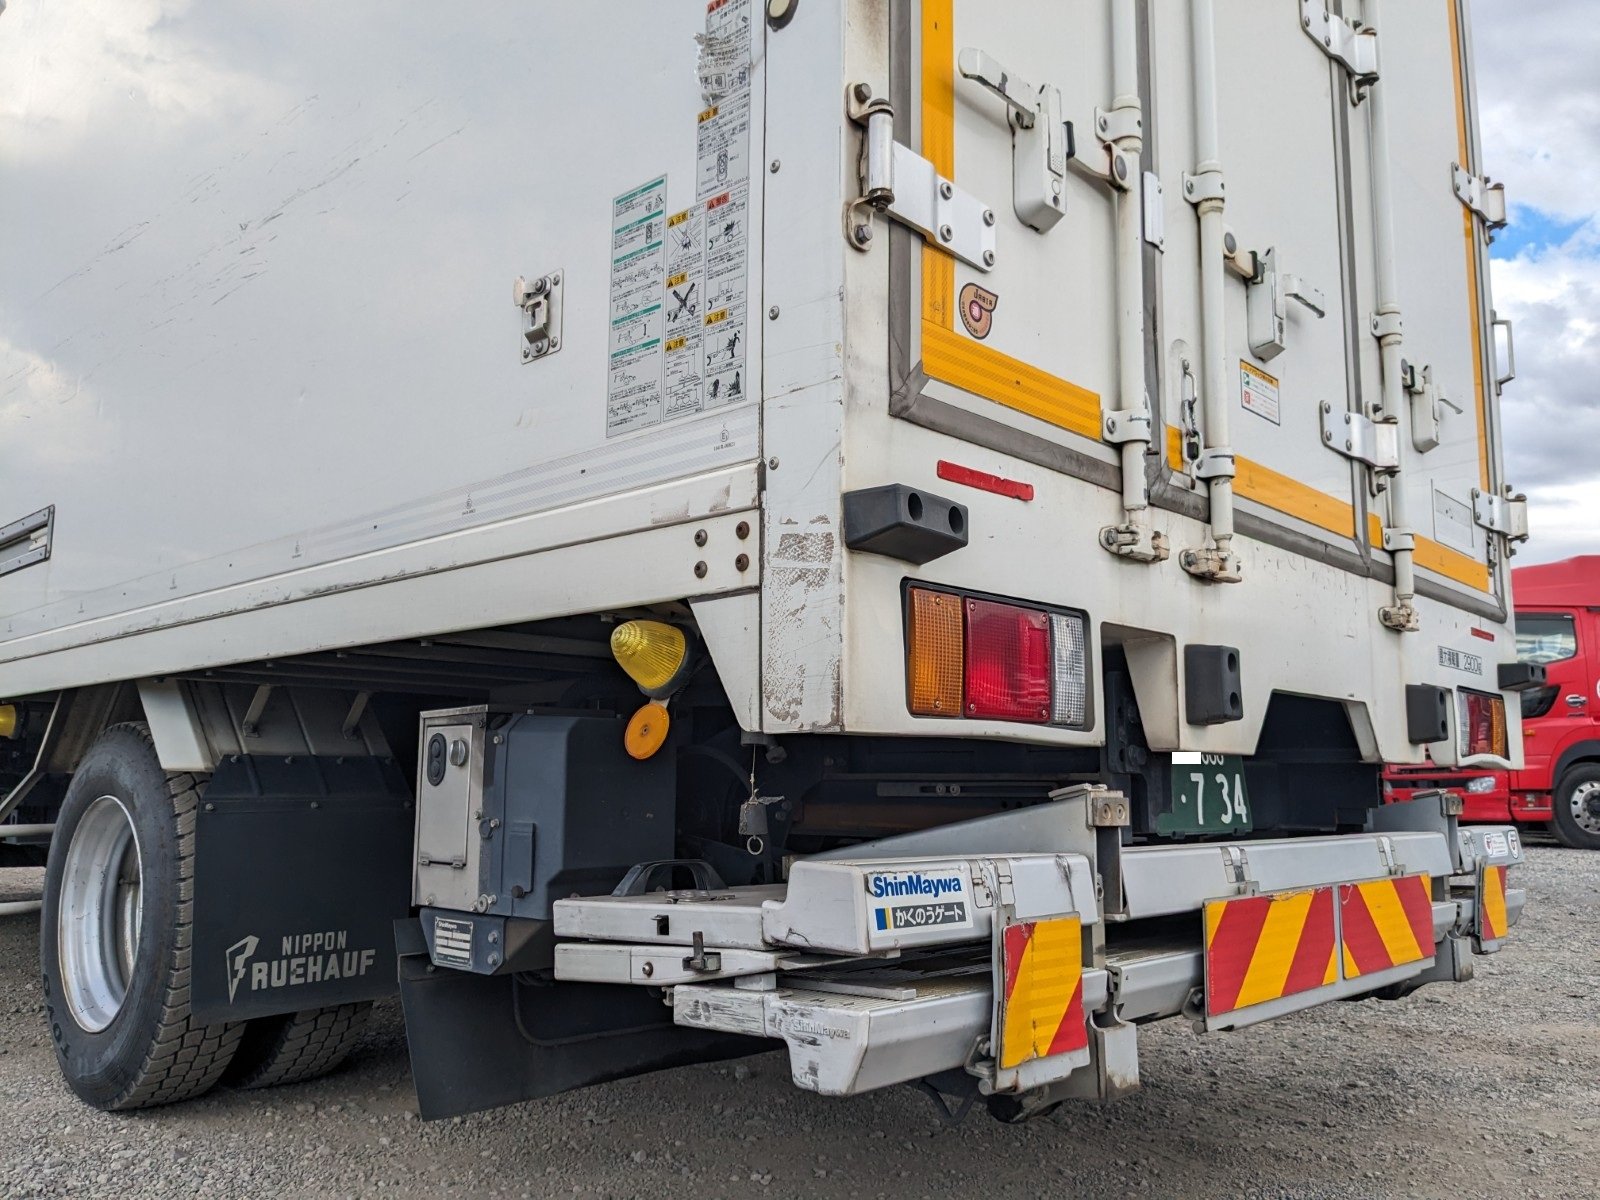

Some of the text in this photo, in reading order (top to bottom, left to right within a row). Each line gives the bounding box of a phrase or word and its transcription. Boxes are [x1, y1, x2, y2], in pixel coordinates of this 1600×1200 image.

[674, 274, 686, 285] 注意
[714, 310, 726, 321] 注意
[673, 338, 685, 350] 注意
[873, 874, 962, 898] ShinMaywa
[895, 904, 963, 927] かくのうゲート
[281, 930, 348, 956] NIPPON
